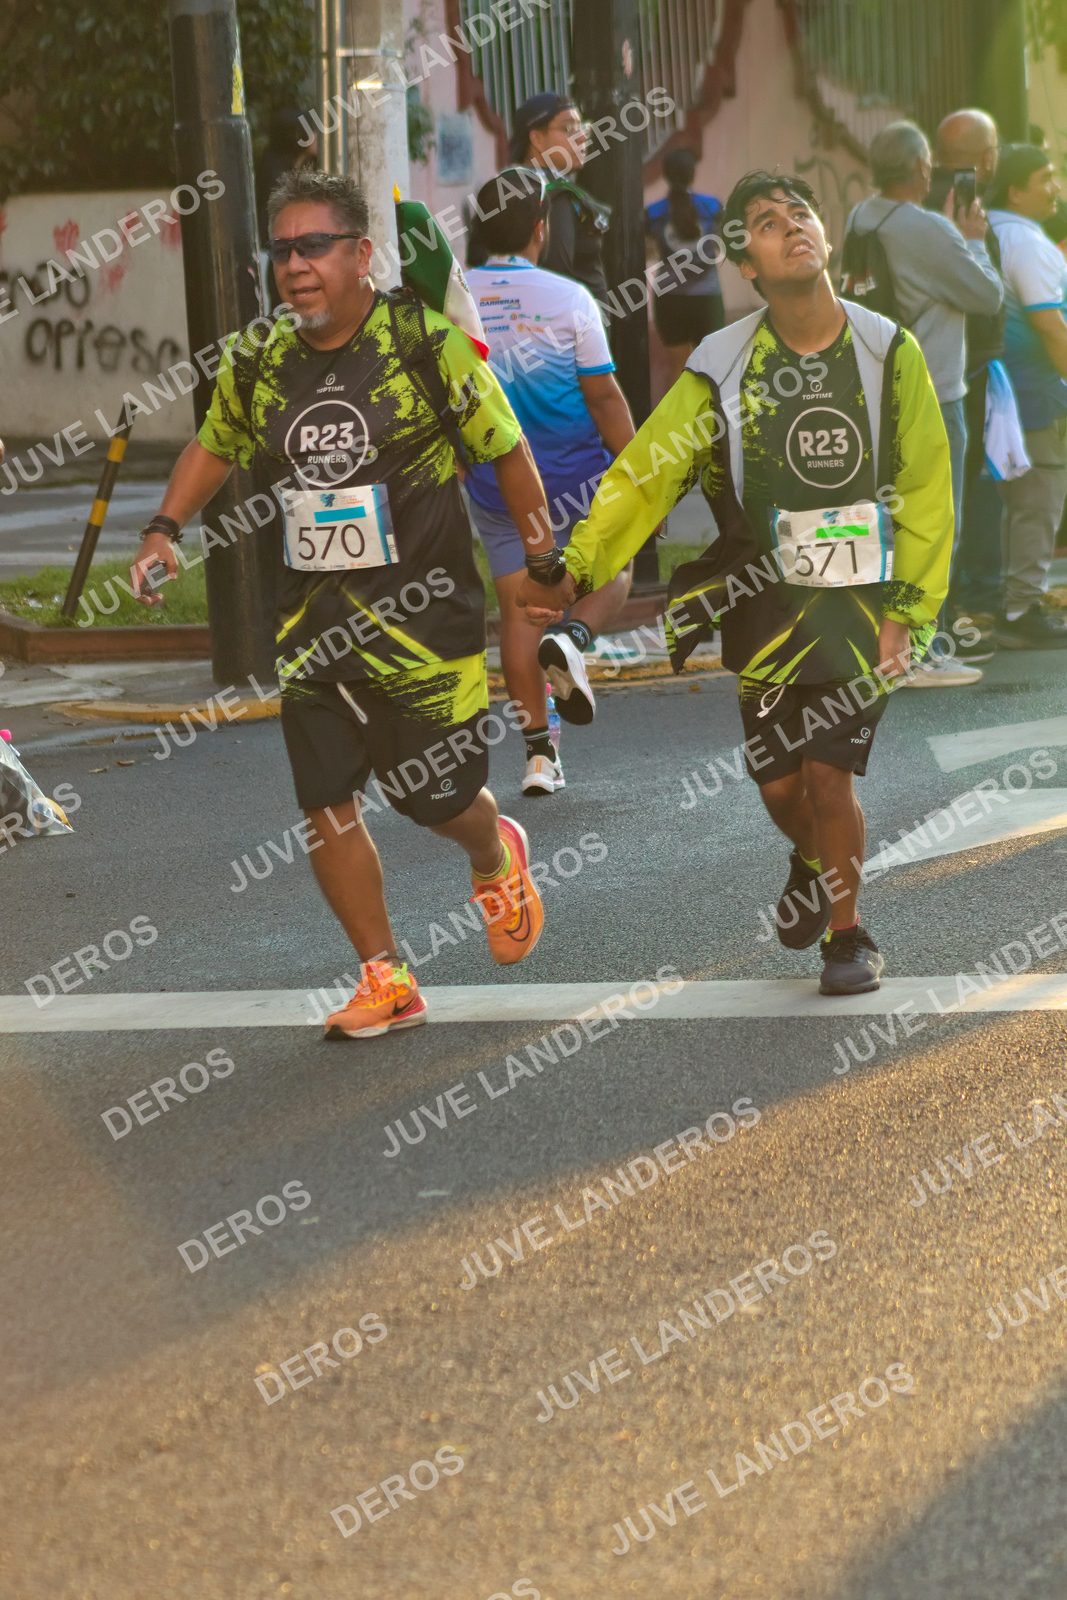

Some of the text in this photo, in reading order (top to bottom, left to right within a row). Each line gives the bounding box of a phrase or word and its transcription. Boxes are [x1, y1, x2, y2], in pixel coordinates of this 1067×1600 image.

[316, 385, 345, 394] TOPTIME
[802, 391, 833, 400] TOPTIME
[299, 421, 354, 453] R23
[798, 428, 849, 457] R23
[307, 454, 347, 464] RUNNERS
[806, 459, 845, 469] RUNNERS
[298, 524, 365, 561] 570
[794, 540, 858, 577] 571
